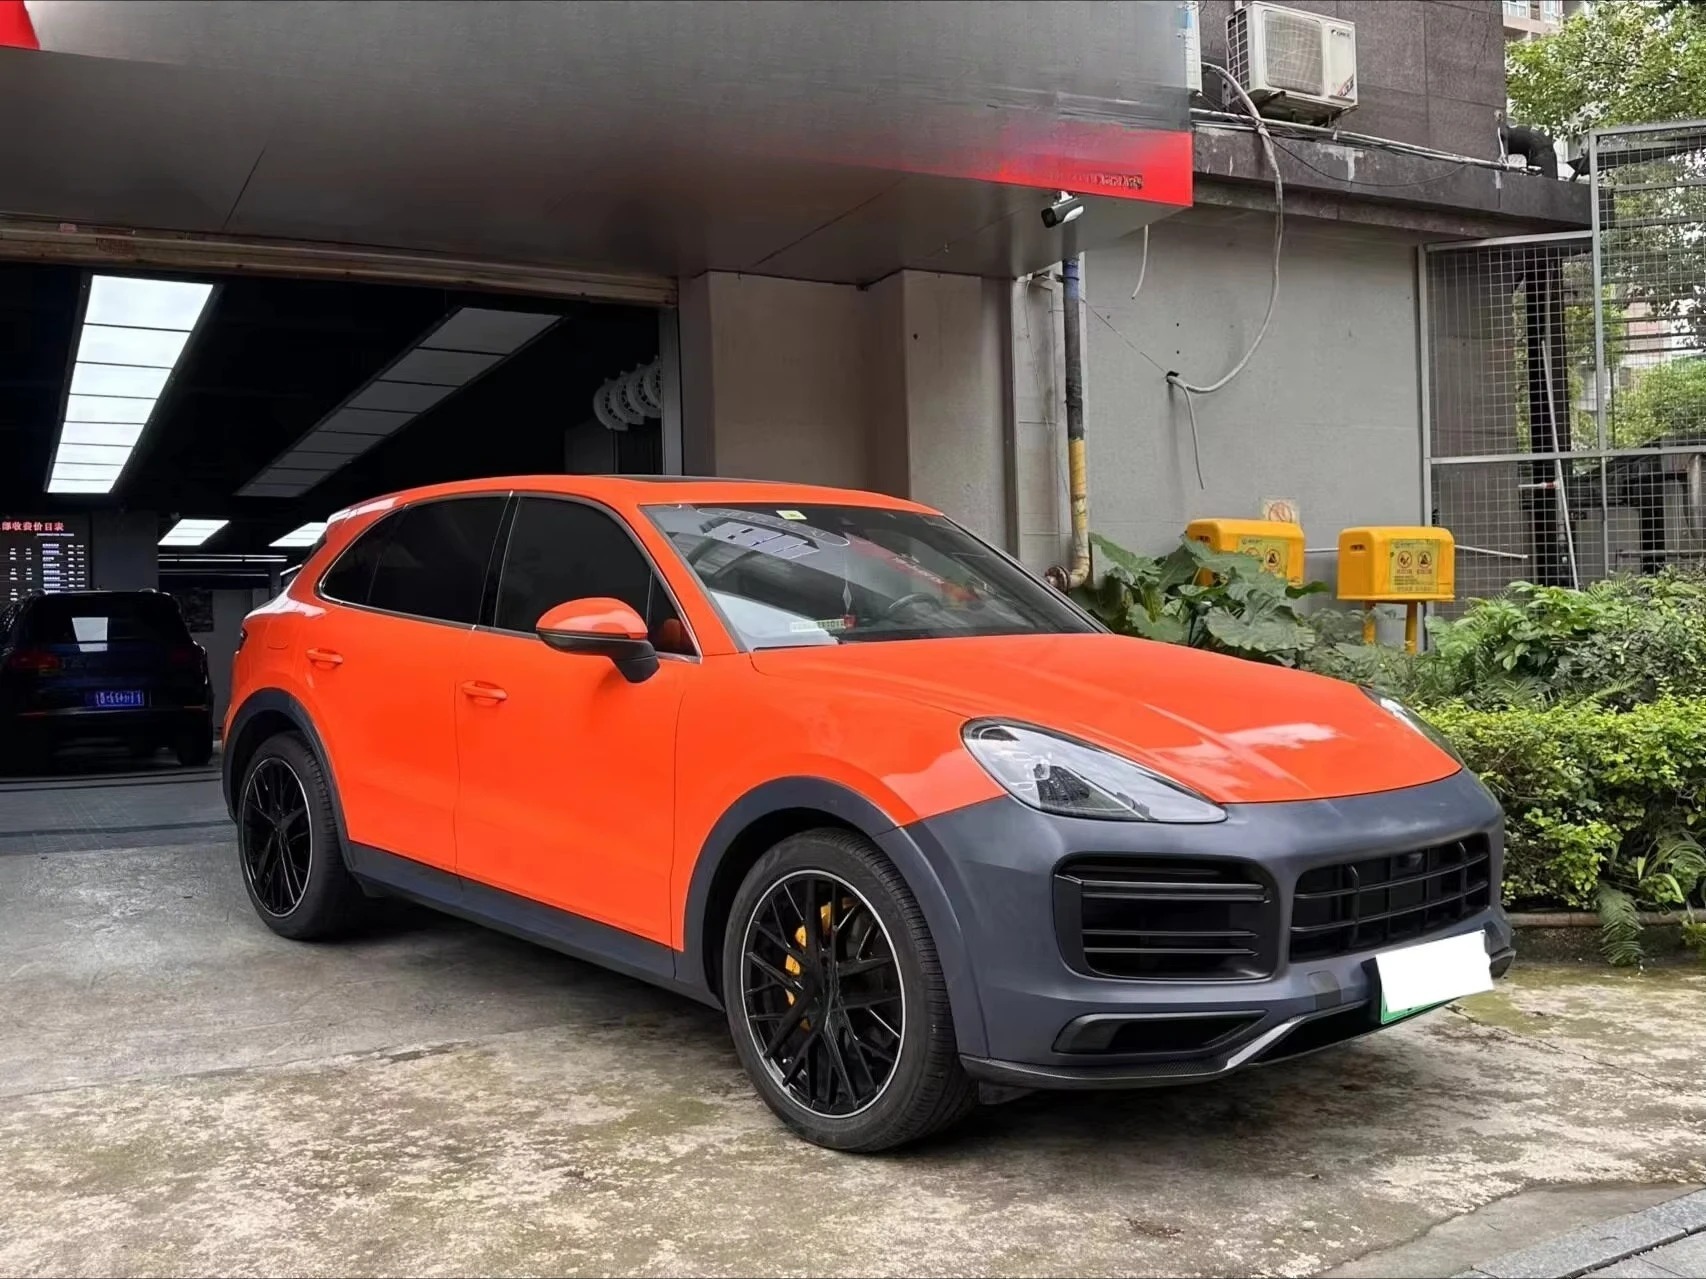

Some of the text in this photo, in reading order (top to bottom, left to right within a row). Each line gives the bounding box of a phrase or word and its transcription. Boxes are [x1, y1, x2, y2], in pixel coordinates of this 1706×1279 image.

[0, 521, 64, 532] 部收费价目表
